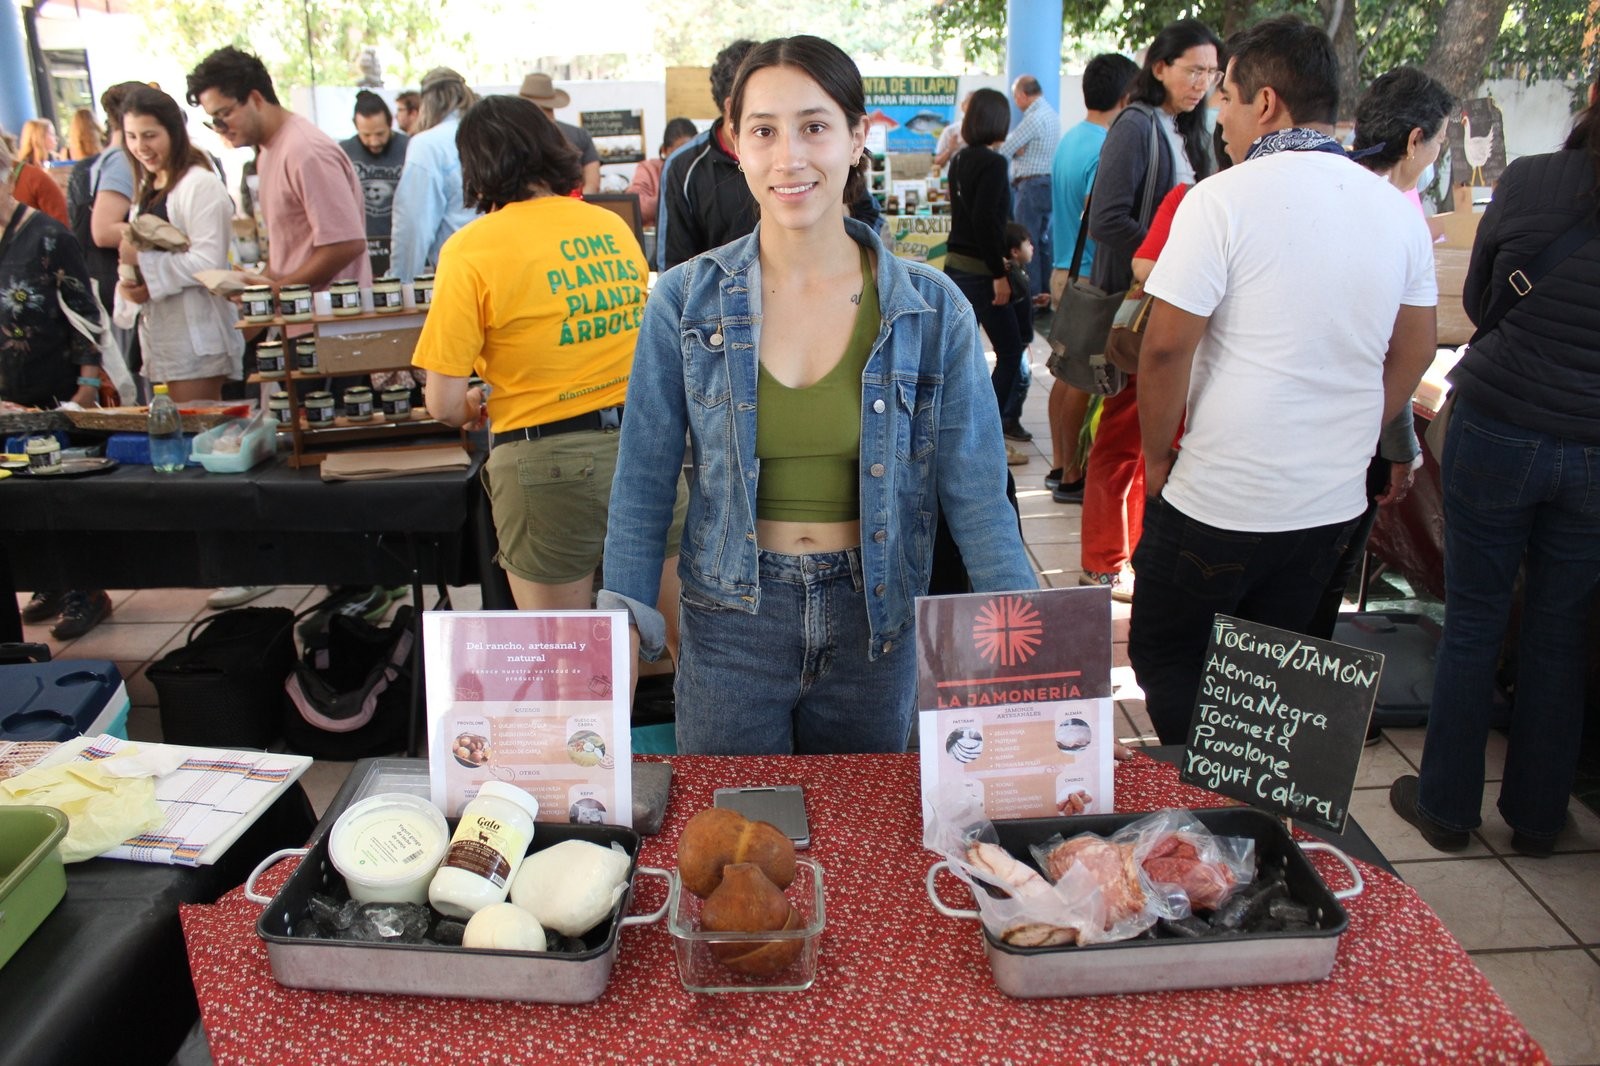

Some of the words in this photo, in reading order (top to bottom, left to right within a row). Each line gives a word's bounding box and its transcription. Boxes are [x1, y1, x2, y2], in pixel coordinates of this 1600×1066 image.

[862, 78, 887, 93] NTA
[890, 78, 906, 93] DE
[910, 77, 956, 93] TILAPIA
[873, 94, 898, 105] PARA
[560, 234, 621, 261] COME
[547, 259, 639, 295] PLANTAS
[559, 306, 644, 346] ÁRBOLE
[466, 642, 483, 650] Del
[486, 642, 525, 651] rancho,
[528, 641, 577, 650] artesanal
[579, 642, 586, 652] y
[507, 654, 546, 662] natural
[937, 695, 961, 709] LA
[967, 684, 1081, 706] JAMONERÍA
[1199, 704, 1291, 752] Tocineta
[1194, 725, 1290, 779] Provolone
[1186, 749, 1253, 789] Yogurt
[477, 816, 500, 830] Galo
